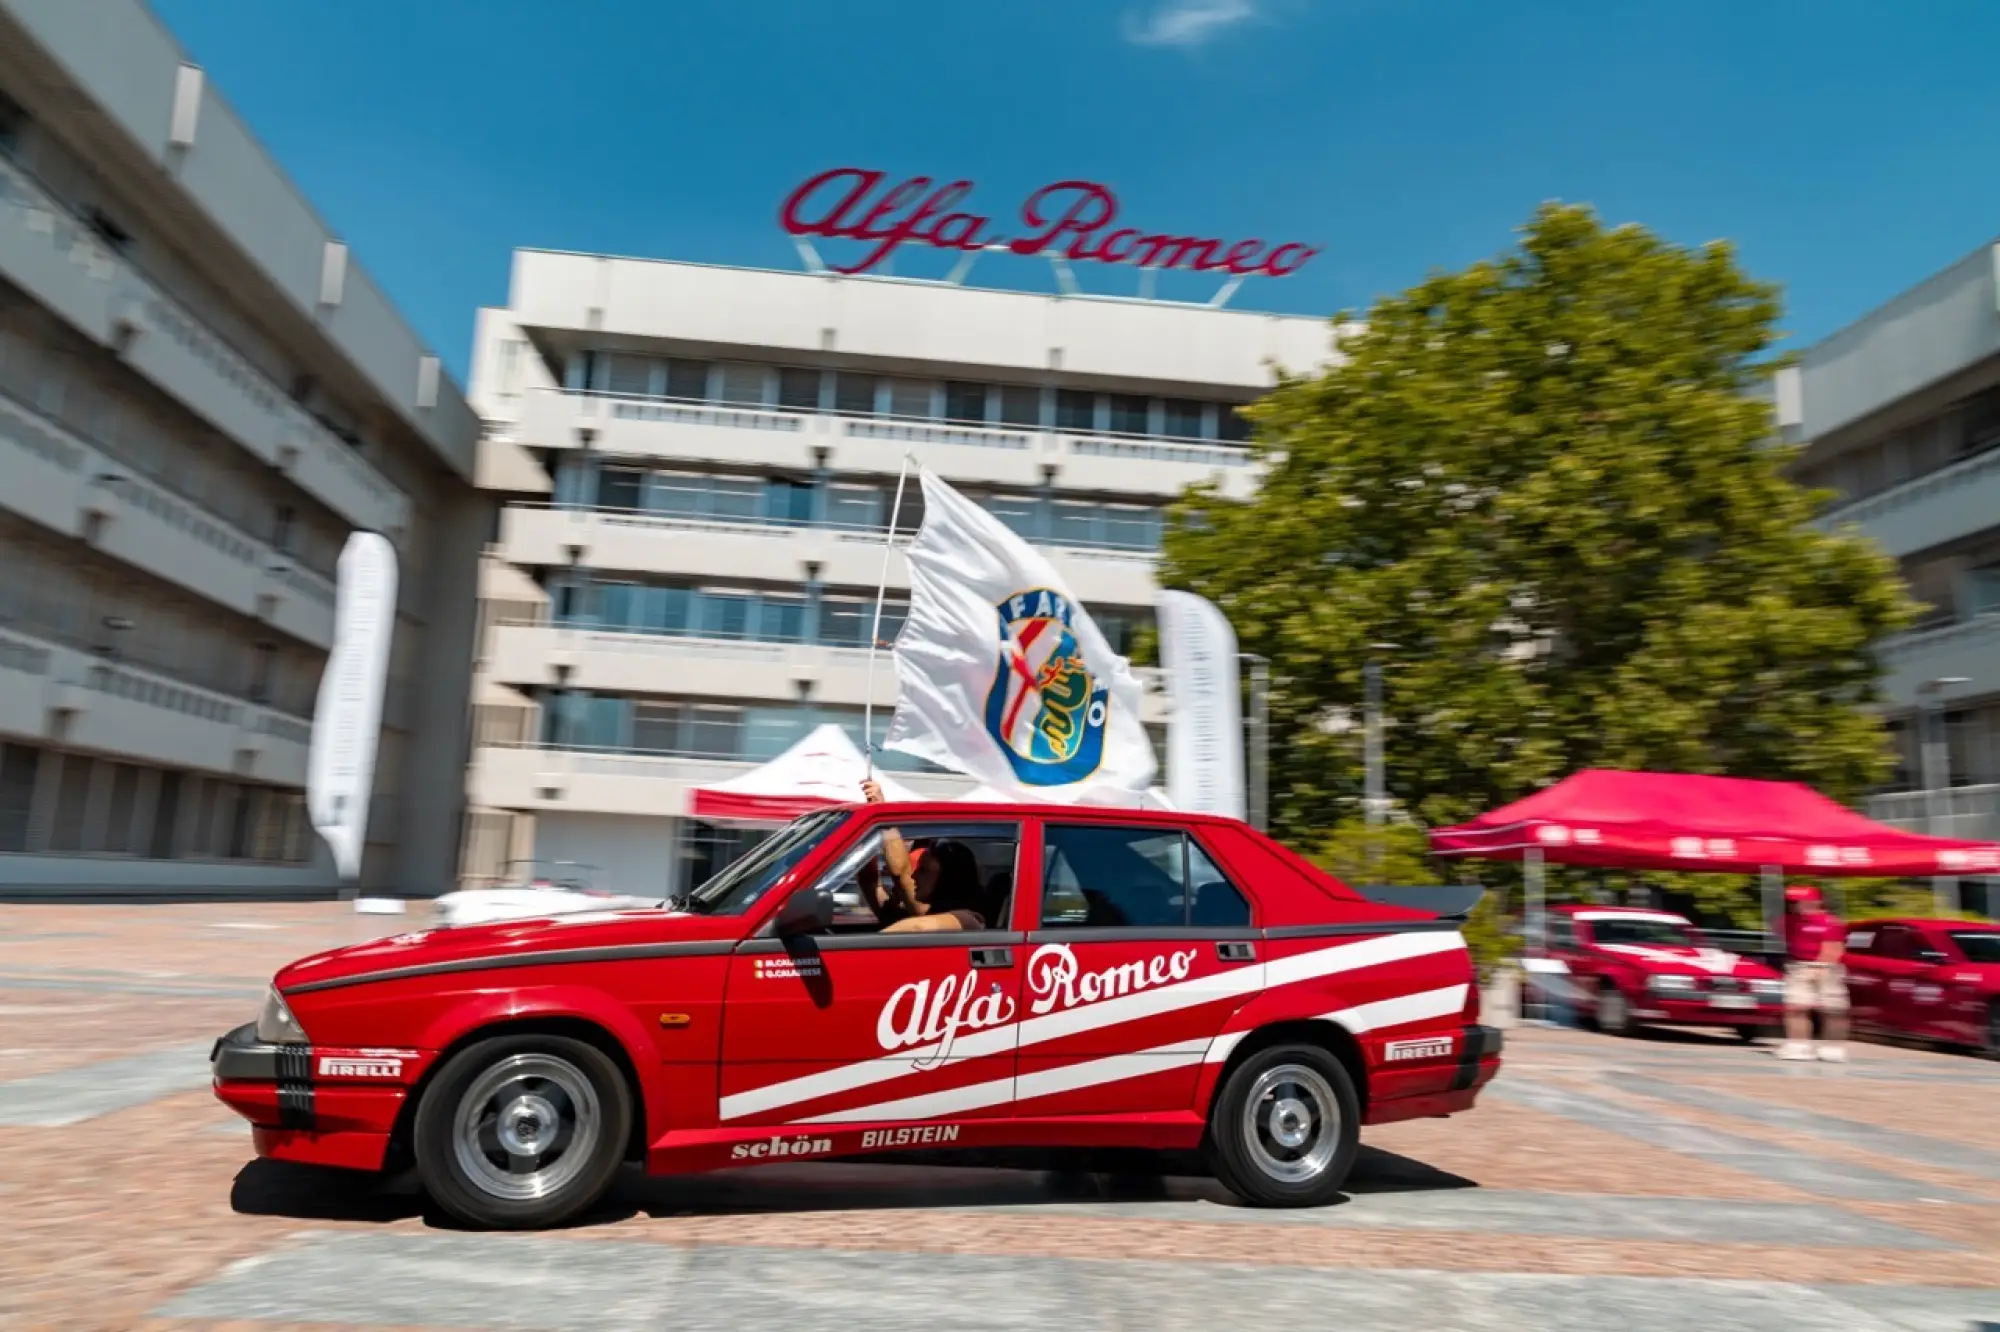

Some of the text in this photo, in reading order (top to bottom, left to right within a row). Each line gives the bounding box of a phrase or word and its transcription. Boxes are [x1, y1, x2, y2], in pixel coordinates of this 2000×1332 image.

[778, 167, 1327, 277] Alfa Romeo
[877, 943, 1198, 1070] Alfa Romeo
[1385, 1036, 1453, 1060] PIRELLI
[319, 1057, 403, 1077] PIRELLI
[731, 1125, 960, 1159] schön BILSTEIN
